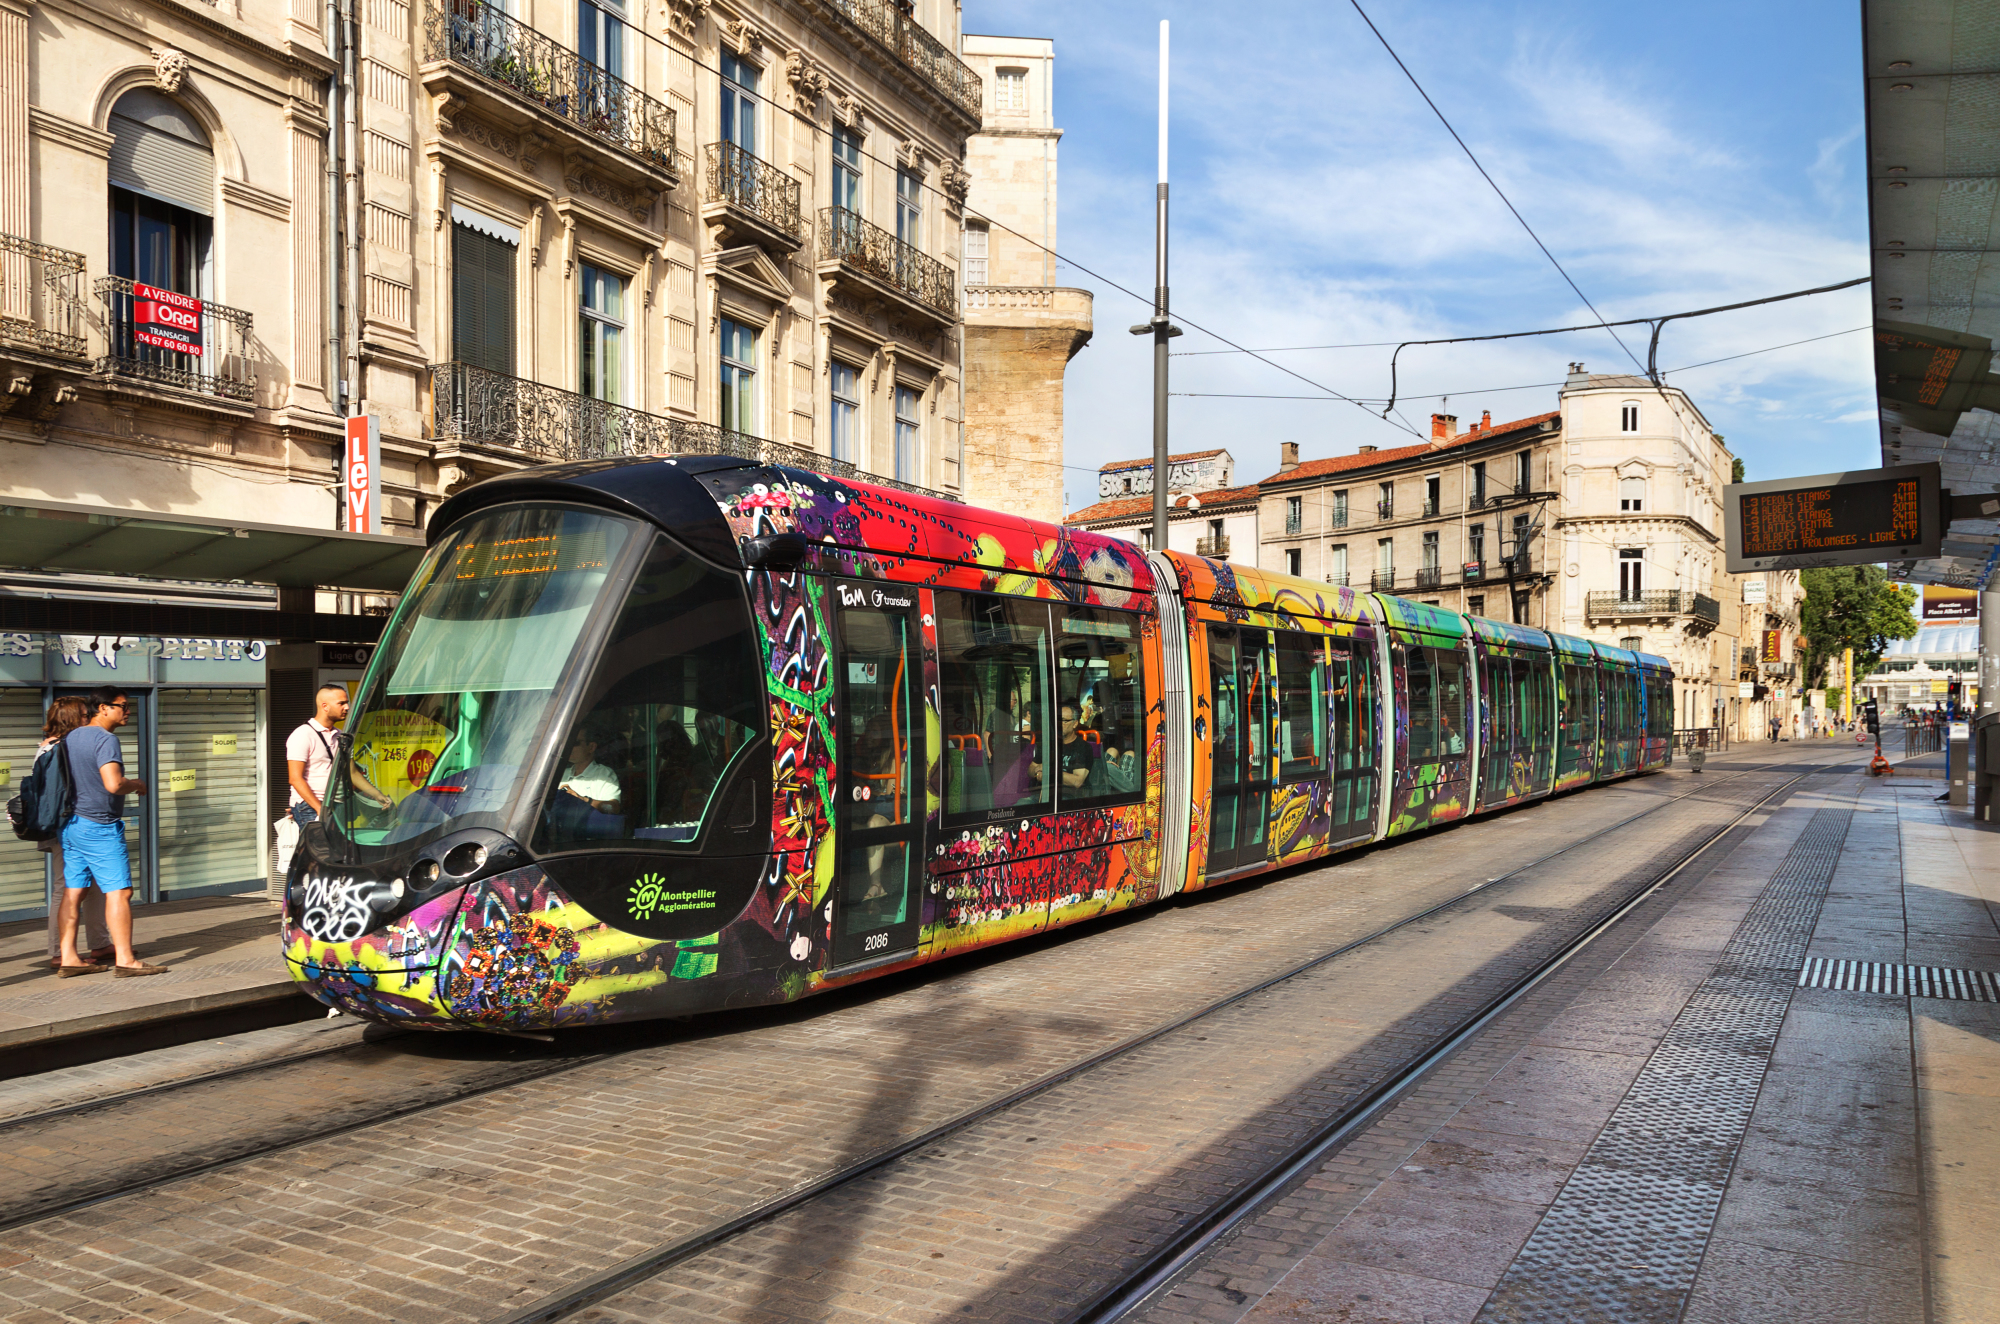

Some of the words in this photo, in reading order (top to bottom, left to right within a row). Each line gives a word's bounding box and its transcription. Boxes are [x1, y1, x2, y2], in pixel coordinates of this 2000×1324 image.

[143, 288, 151, 297] A
[152, 289, 194, 309] VENDRE
[158, 306, 196, 328] ORPI
[139, 334, 150, 343] 04
[152, 337, 162, 345] 67
[164, 340, 174, 348] 60
[177, 343, 187, 351] 60
[189, 346, 199, 354] 80
[149, 327, 189, 342] TRANSAGRI
[1762, 494, 1793, 506] PEROLS
[1797, 490, 1830, 502] ETANGS
[1762, 503, 1794, 515] ALBERT
[1799, 502, 1814, 512] 1ER
[1893, 492, 1917, 502] 14MN
[1762, 513, 1794, 524] PEROLS
[1798, 509, 1831, 521] ETANGS
[1893, 501, 1917, 512] 20MN
[1763, 522, 1796, 533] LATTES
[1800, 518, 1833, 530] CENTRE
[1893, 511, 1917, 521] 24MN
[1763, 531, 1795, 542] ALBERT
[1800, 529, 1816, 539] 1ER
[1893, 520, 1917, 530] 44MN
[1787, 540, 1798, 550] ET
[1803, 534, 1857, 548] PROLONGEES
[1870, 531, 1897, 542] LIGNE
[1901, 531, 1907, 539] 4
[1911, 530, 1917, 539] P
[884, 596, 911, 607] transdev
[1768, 630, 1776, 657] Panama
[330, 651, 353, 661] Ligne
[375, 716, 390, 726] FINI
[393, 716, 403, 726] LA
[988, 808, 1015, 819] Posidonie
[661, 890, 716, 901] Montpellier
[658, 901, 715, 913] Agglomération
[865, 933, 888, 951] 2086
